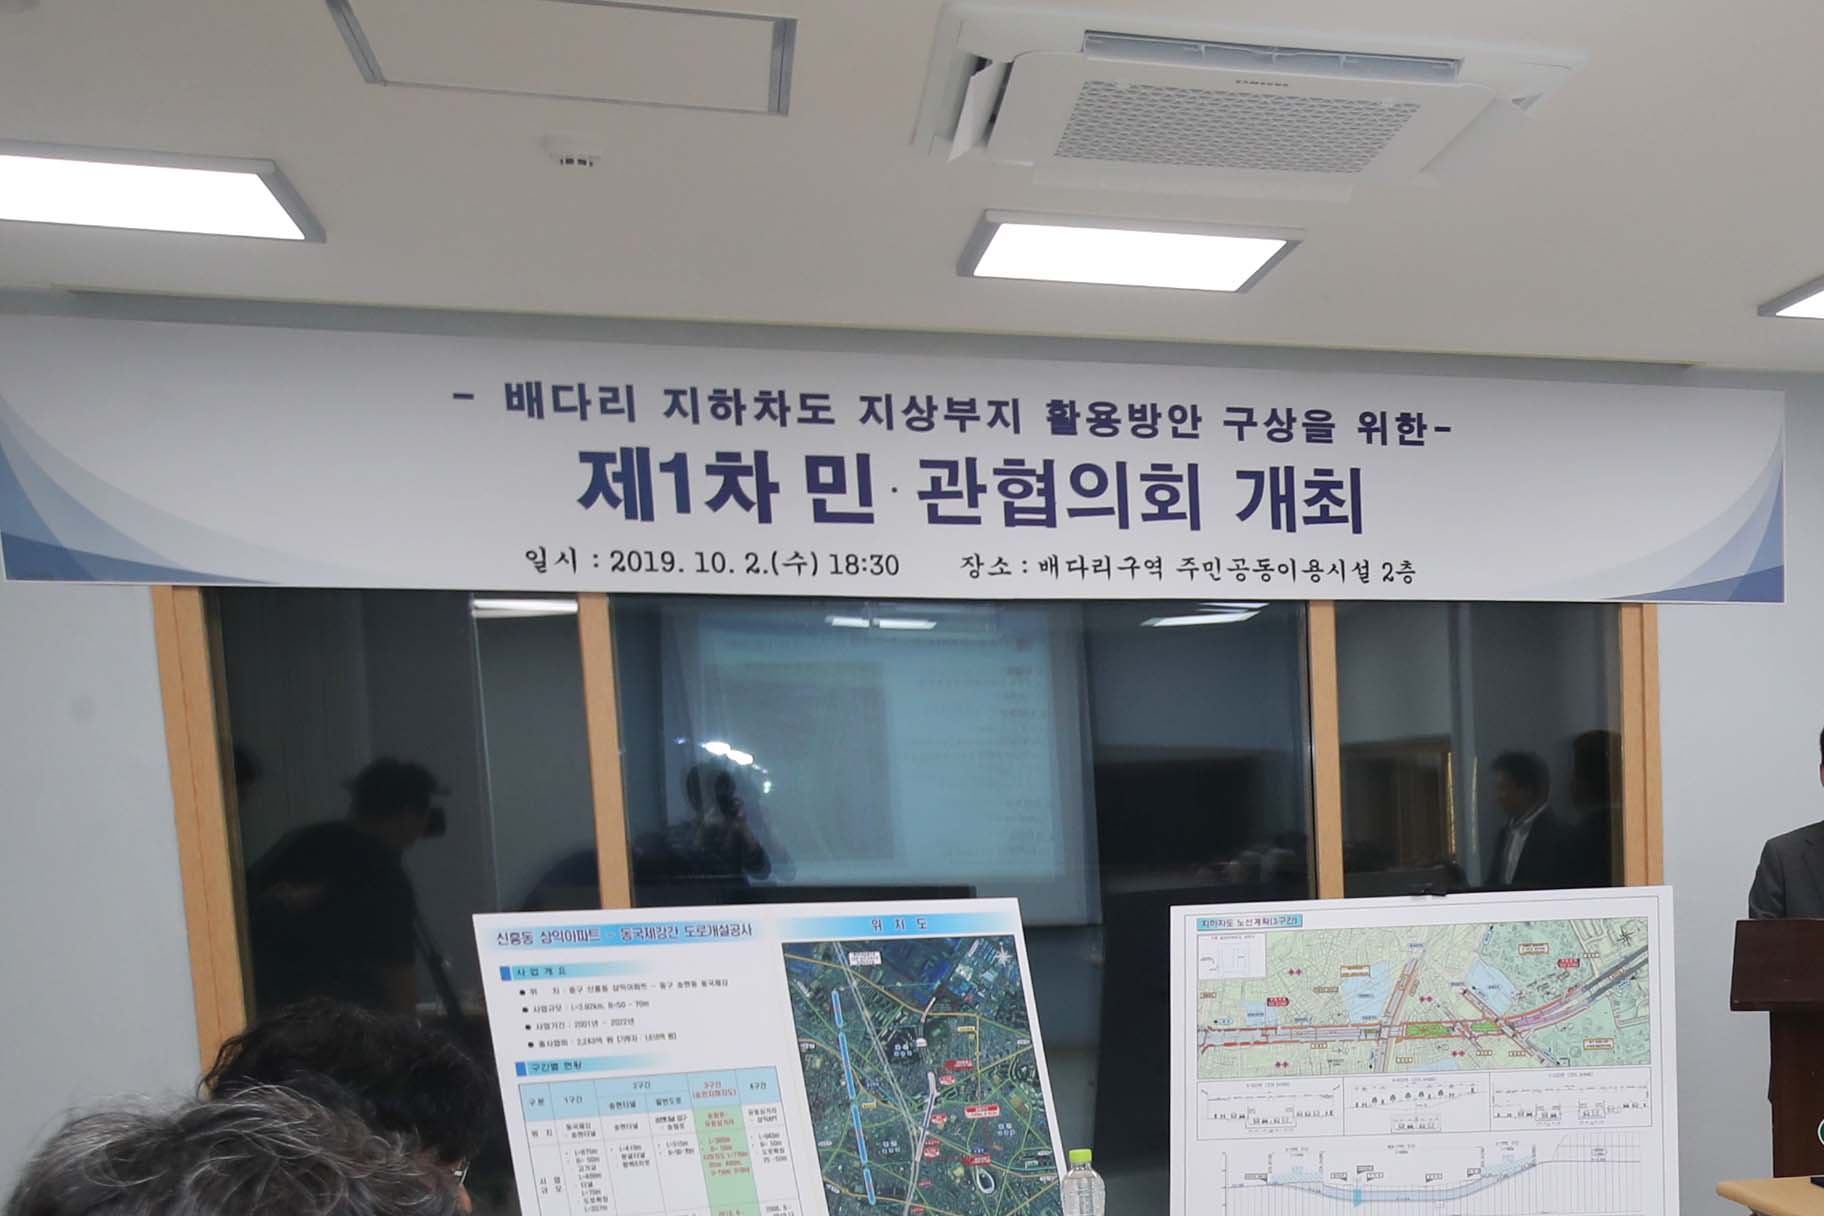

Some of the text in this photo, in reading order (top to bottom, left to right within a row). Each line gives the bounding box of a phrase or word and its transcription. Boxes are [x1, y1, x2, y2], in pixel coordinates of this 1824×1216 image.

[505, 382, 635, 422] 배다리
[664, 387, 835, 427] 지하차도
[860, 394, 1020, 434] 지상부지
[1046, 400, 1202, 439] 활용방안
[1224, 407, 1335, 443] 구상을
[577, 447, 779, 524] 제1차
[1236, 466, 1363, 534] 개최
[525, 546, 577, 573] 일시
[829, 553, 900, 576] 18:30
[961, 553, 1012, 579] 장소
[1038, 554, 1164, 580] 배다리구역
[1177, 556, 1370, 584] 주민공동이용시설
[1381, 560, 1416, 584] 2층
